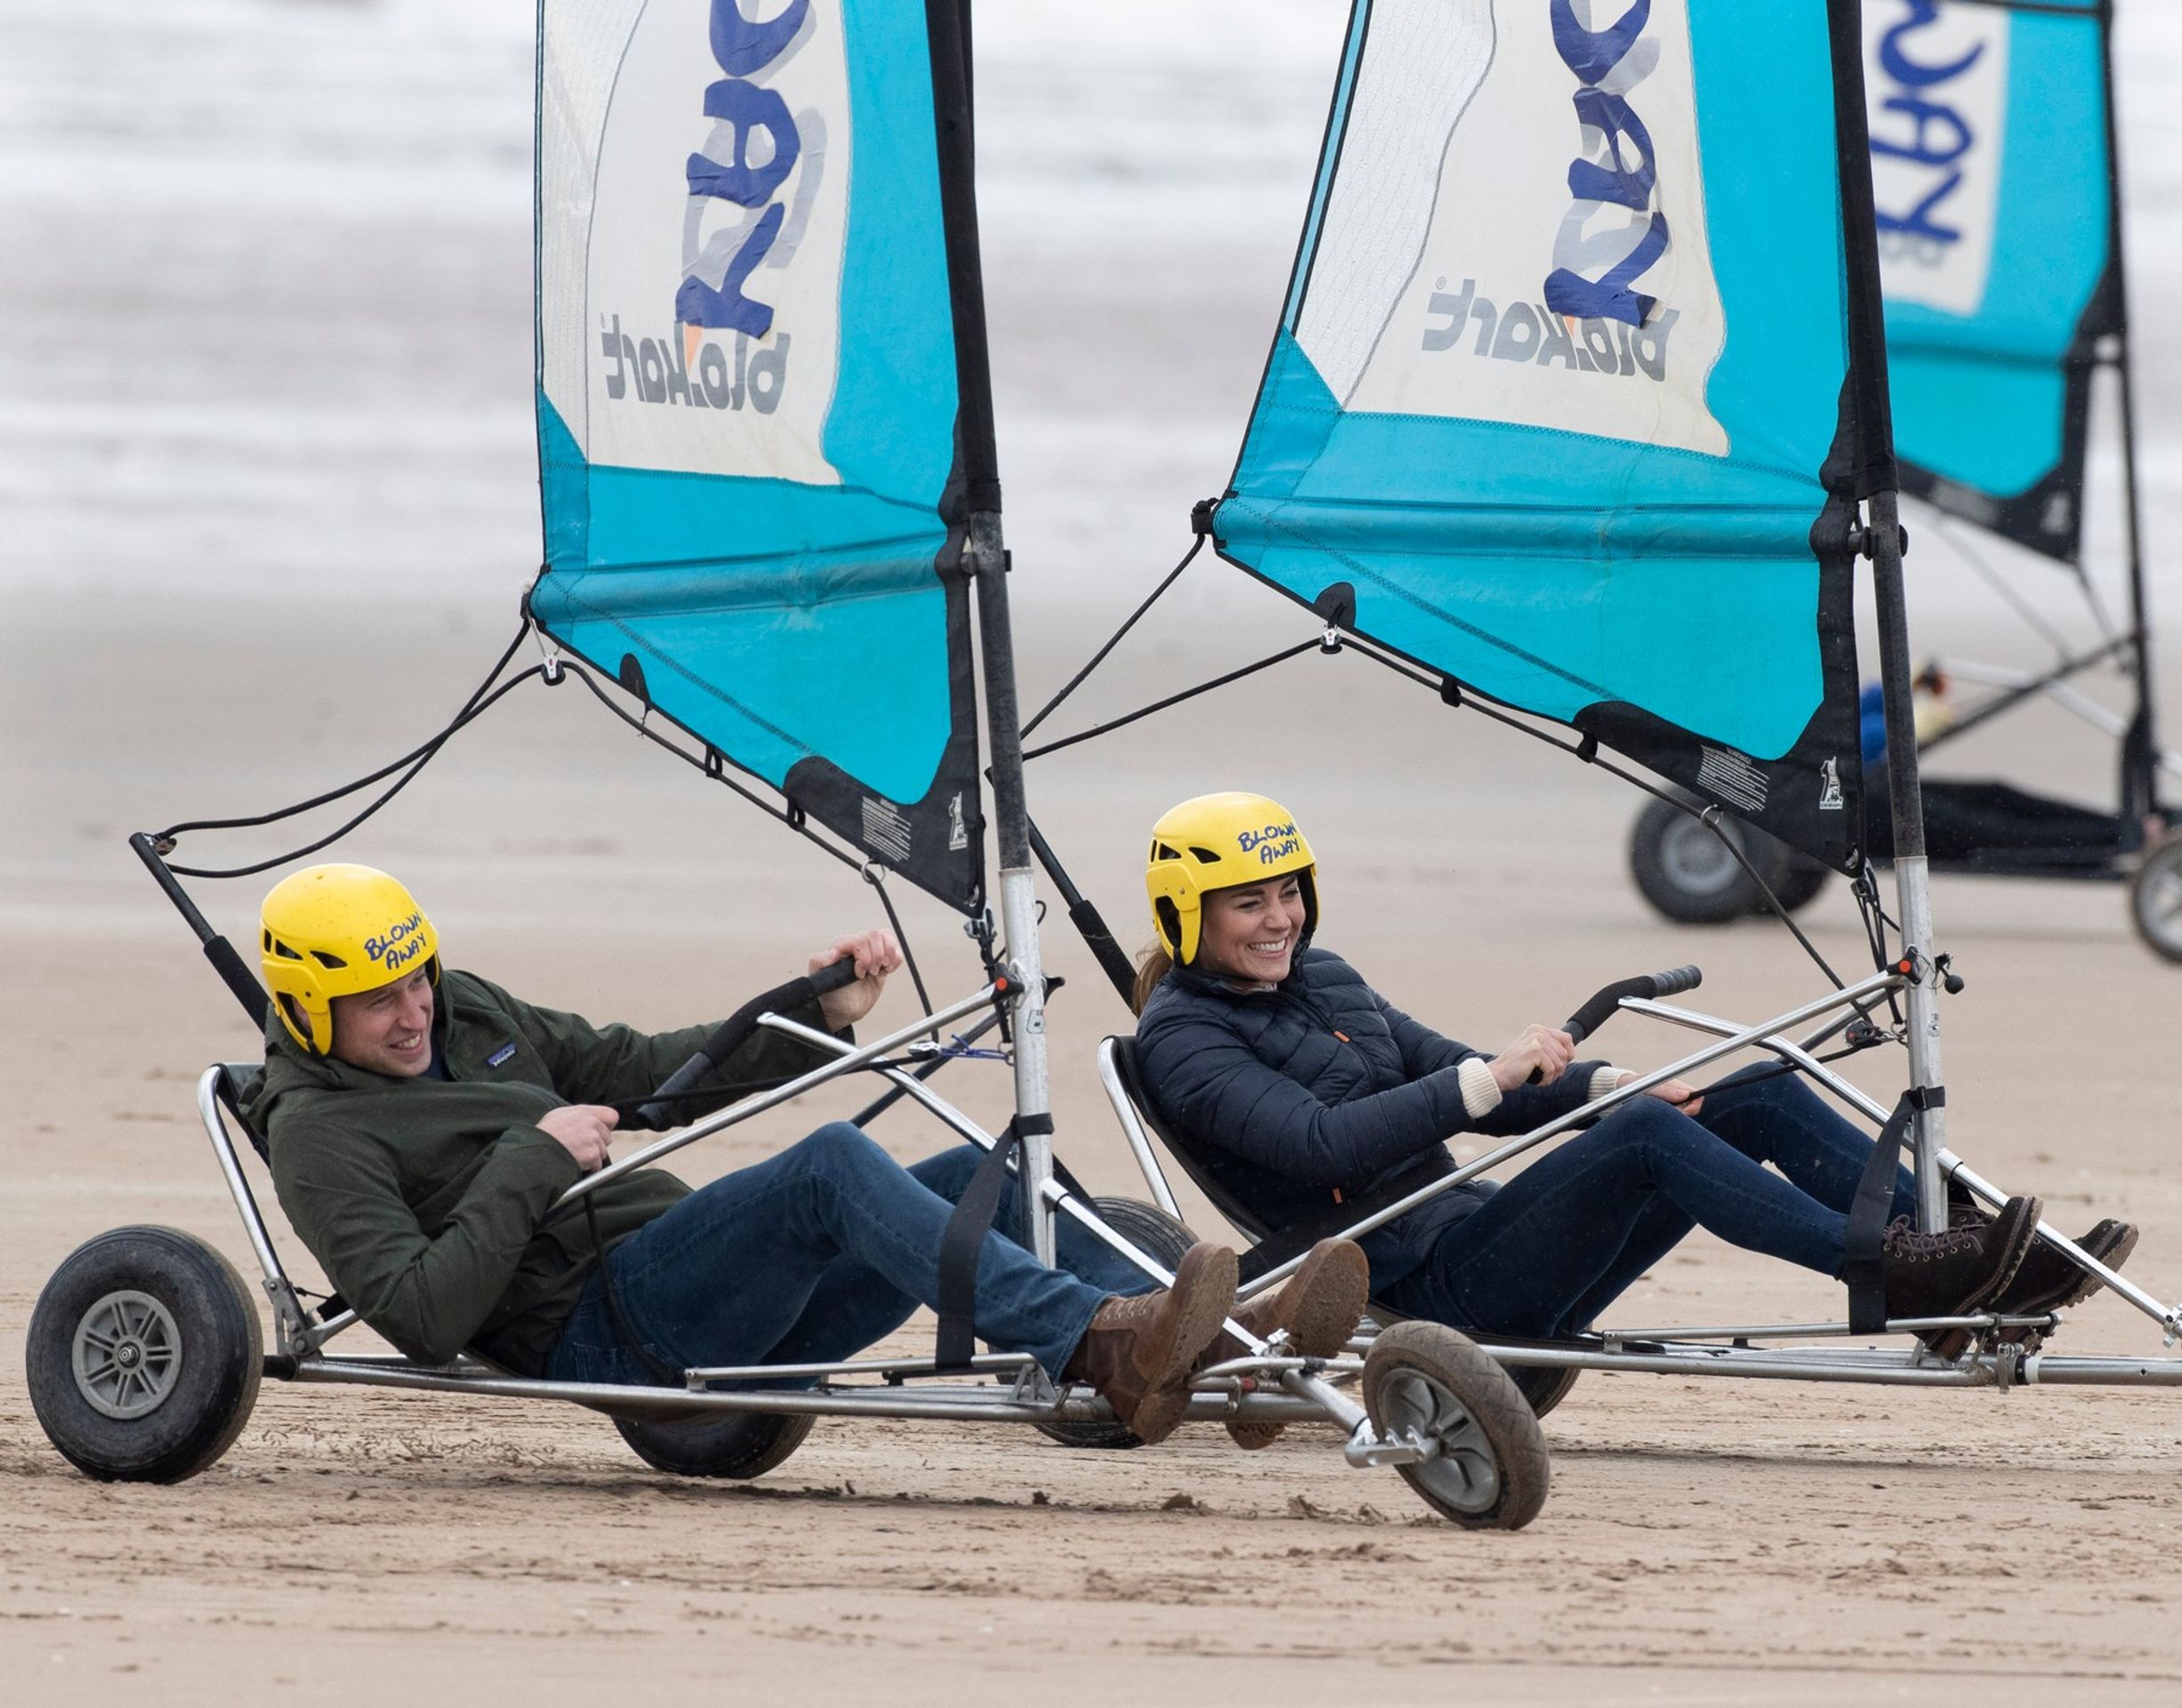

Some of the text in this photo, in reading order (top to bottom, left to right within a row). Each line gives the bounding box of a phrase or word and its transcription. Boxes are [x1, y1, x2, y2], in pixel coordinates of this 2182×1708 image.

[1237, 823, 1297, 851] BLOWN
[1260, 838, 1300, 864] AWAY
[364, 912, 422, 961] BLOWN
[386, 933, 427, 970] AWAY
